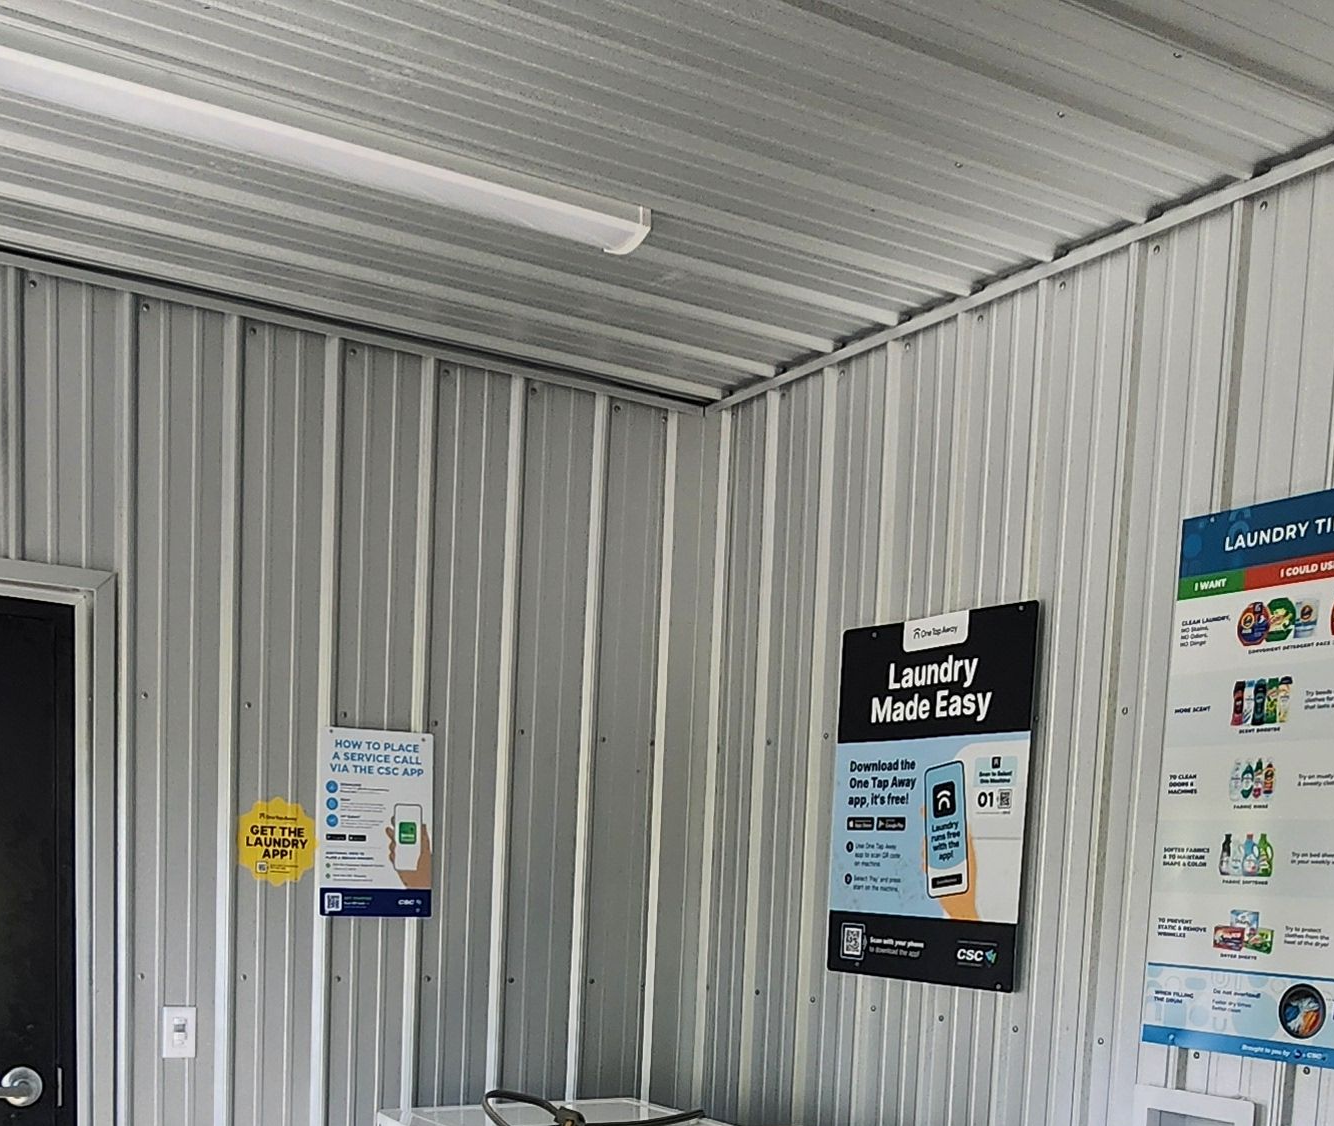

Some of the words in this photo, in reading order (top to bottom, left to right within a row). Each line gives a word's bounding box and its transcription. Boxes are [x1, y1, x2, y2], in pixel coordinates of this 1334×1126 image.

[1224, 520, 1310, 551] LAUNDRY
[1280, 568, 1285, 578] I
[1285, 563, 1318, 577] COULD
[1194, 582, 1199, 591] I
[1199, 578, 1227, 590] WANT
[921, 630, 931, 638] One
[941, 626, 958, 634] Away
[888, 655, 979, 690] Laundry
[870, 693, 930, 724] Made
[935, 690, 993, 721] Easy
[335, 739, 362, 749] HOW
[365, 741, 380, 750] TO
[384, 743, 419, 753] PLACE
[332, 752, 340, 760] A
[343, 752, 391, 763] SERVICE
[393, 756, 422, 765] CALL
[330, 763, 349, 773] VIA
[353, 765, 374, 774] THE
[377, 766, 399, 776] CSC
[402, 768, 424, 777] APP
[850, 759, 899, 772] Download
[901, 759, 916, 770] the
[849, 778, 869, 788] One
[871, 777, 889, 791] Tap
[891, 776, 917, 790] Away
[848, 796, 869, 808] app,
[871, 793, 885, 805] it's
[887, 792, 909, 805] free!
[978, 792, 993, 807] 01
[250, 825, 276, 836] GET
[279, 826, 305, 837] THE
[932, 821, 958, 832] Laundry
[246, 836, 308, 849] LAUNDRY
[931, 834, 945, 842] runs
[947, 831, 960, 839] free
[933, 842, 947, 851] with
[262, 849, 292, 860] APP!
[939, 850, 953, 861] app!
[870, 936, 882, 944] Scan
[957, 949, 984, 961] CSC
[1241, 1044, 1264, 1054] Brought
